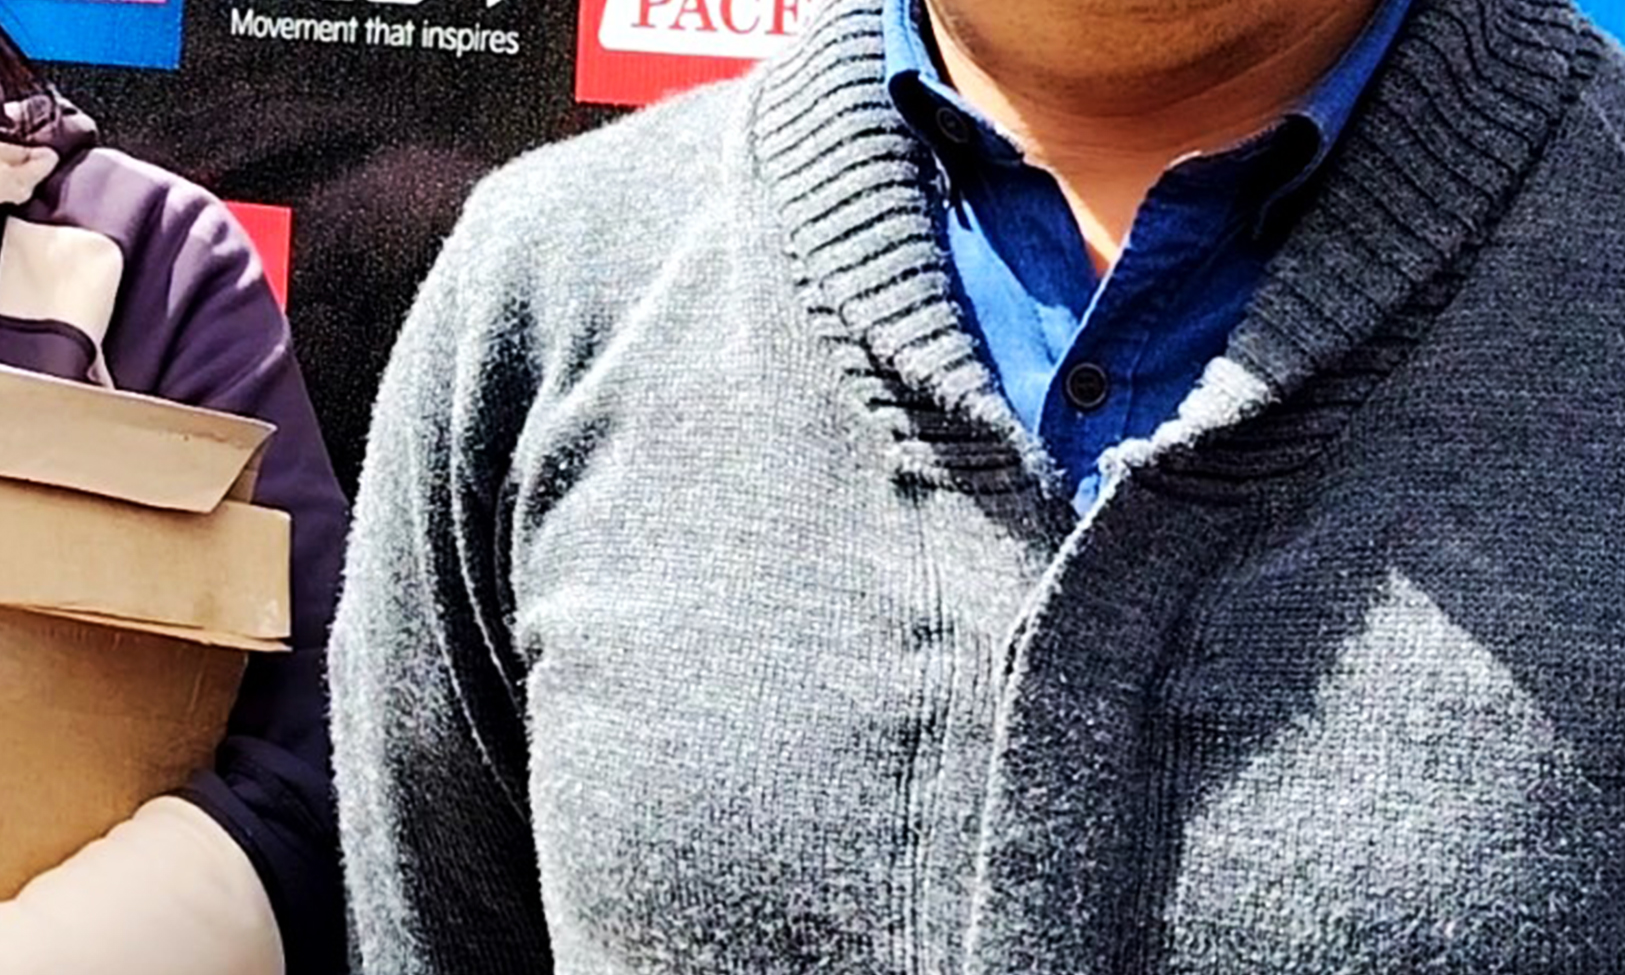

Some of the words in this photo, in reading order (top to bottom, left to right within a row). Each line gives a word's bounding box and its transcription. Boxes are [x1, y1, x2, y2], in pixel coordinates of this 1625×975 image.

[230, 7, 359, 44] Movement
[365, 16, 415, 46] that
[421, 19, 520, 58] inspires
